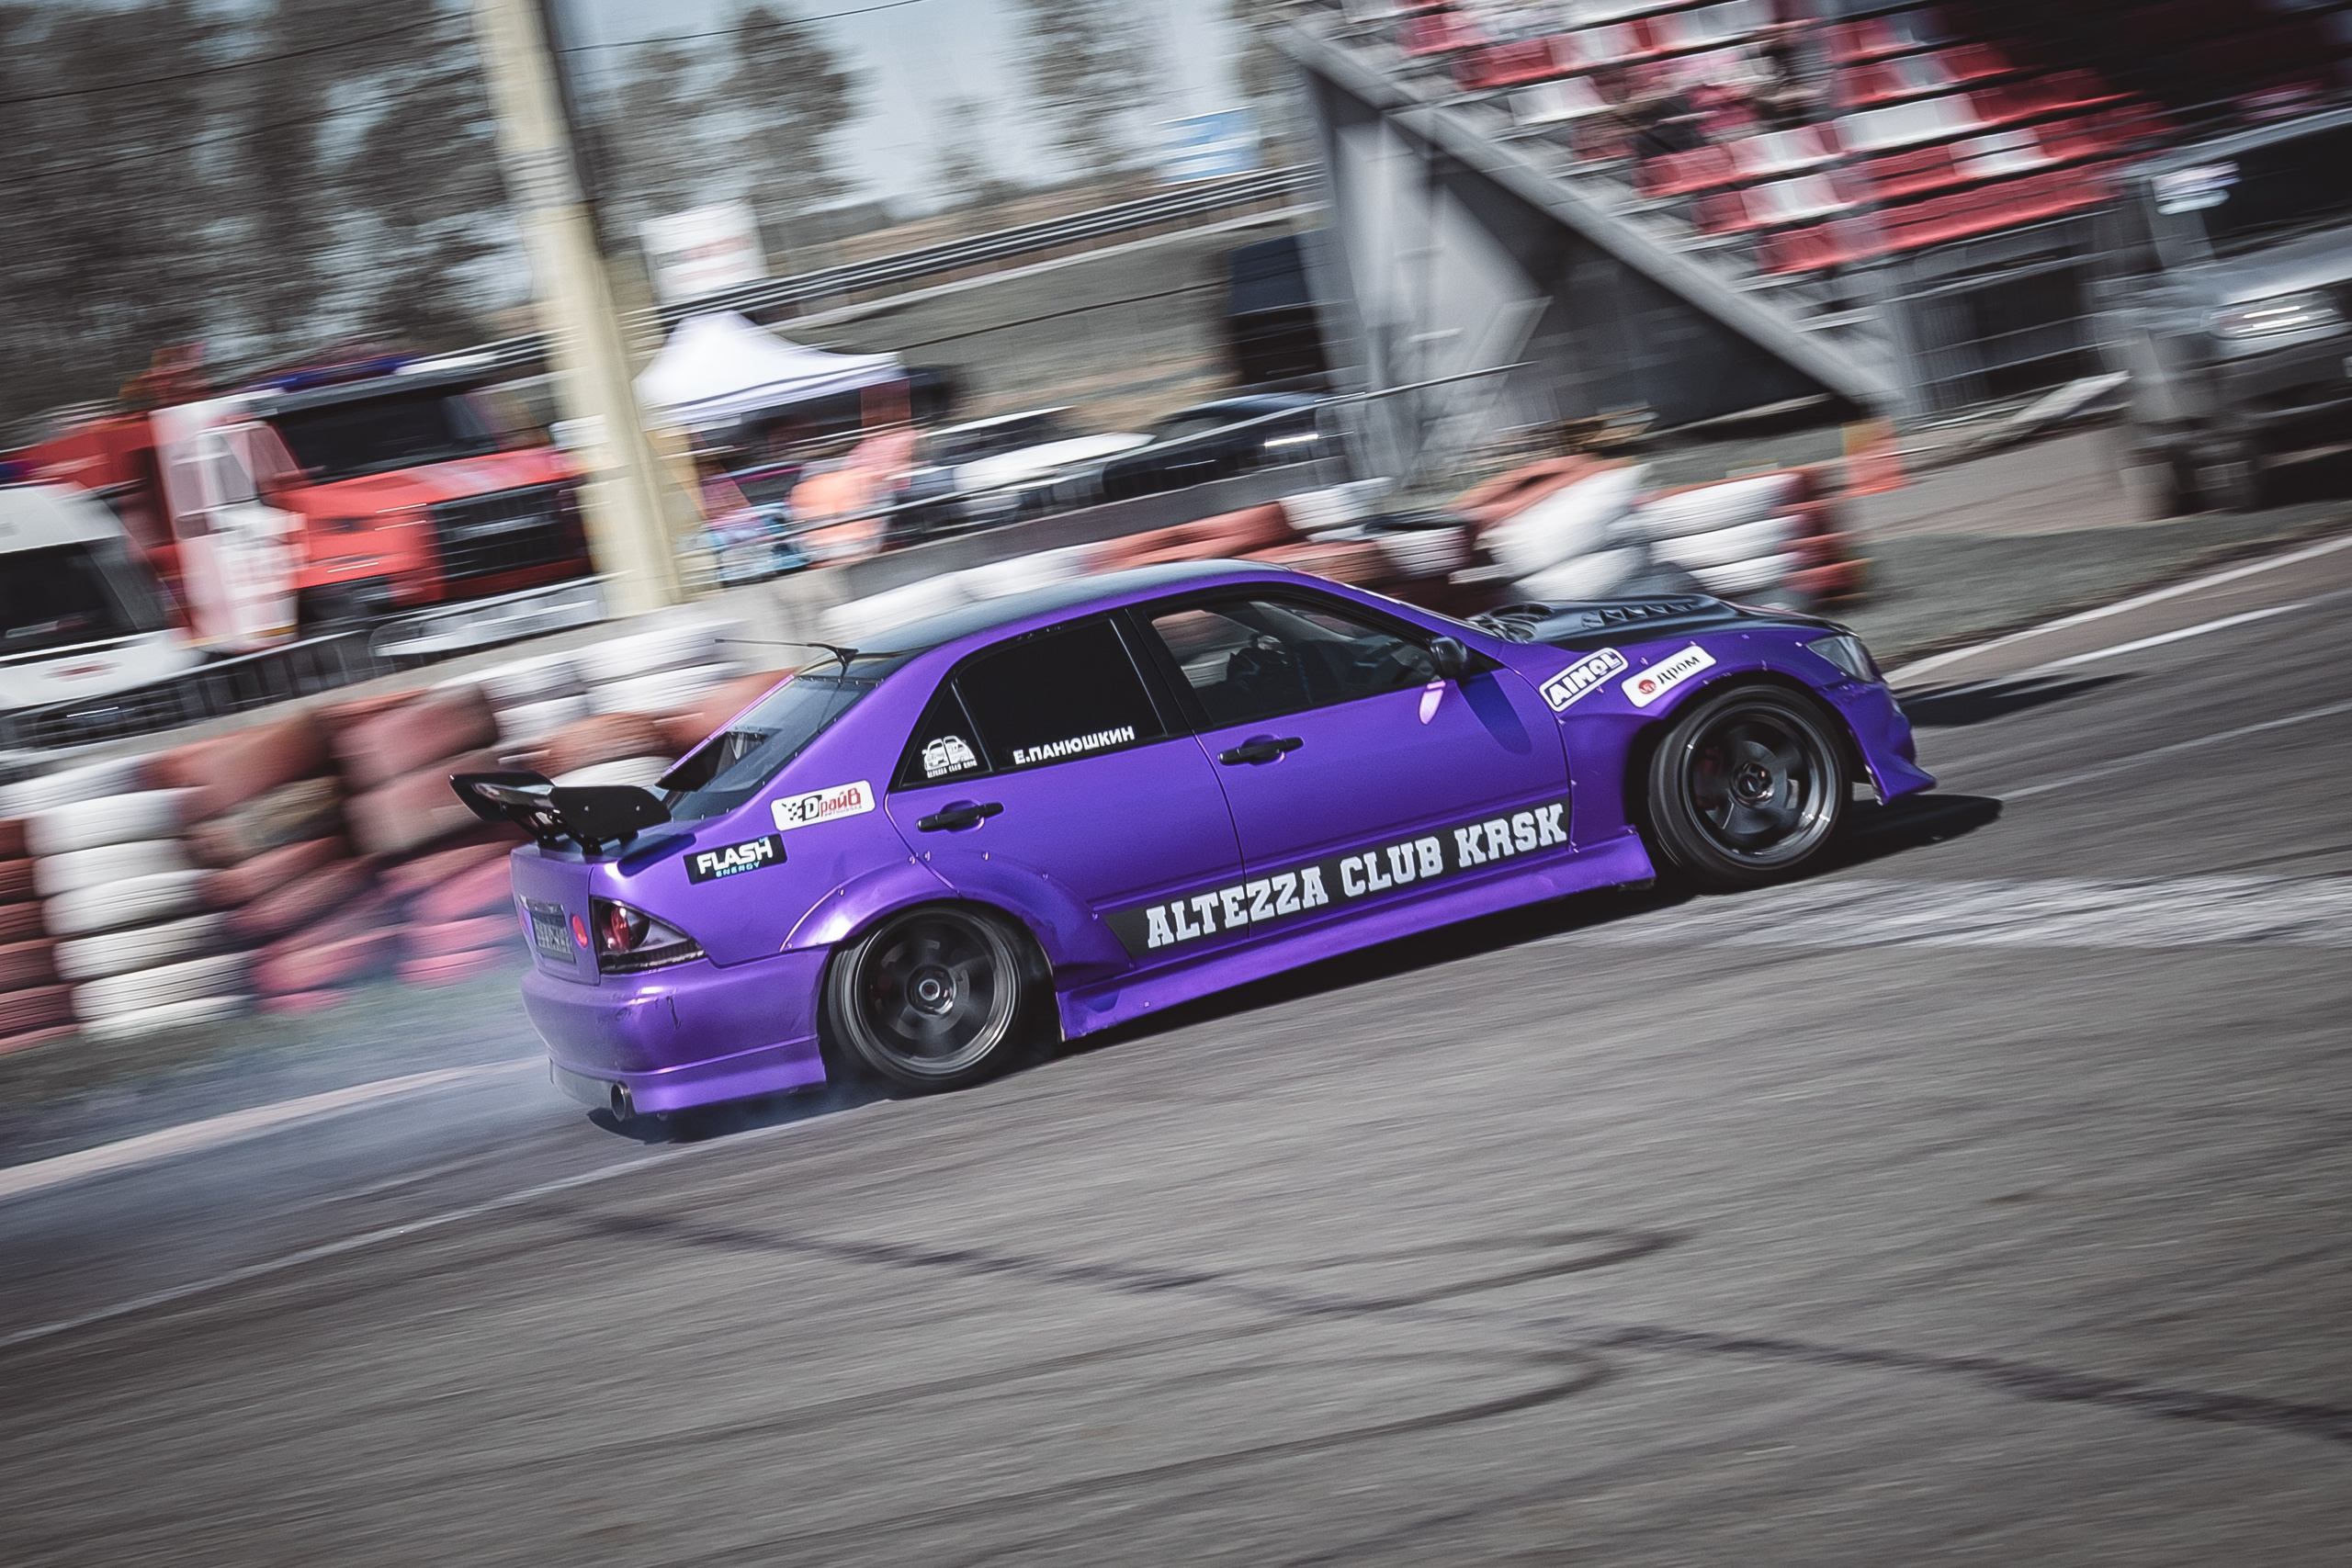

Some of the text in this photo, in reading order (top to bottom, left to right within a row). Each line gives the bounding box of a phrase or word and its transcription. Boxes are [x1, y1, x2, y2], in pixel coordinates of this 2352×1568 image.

[1012, 726, 1135, 764] Е.ПАНЮШКИН
[696, 839, 773, 874] FLASH
[1147, 803, 1566, 948] ALTEZZA CLUB KRSK
